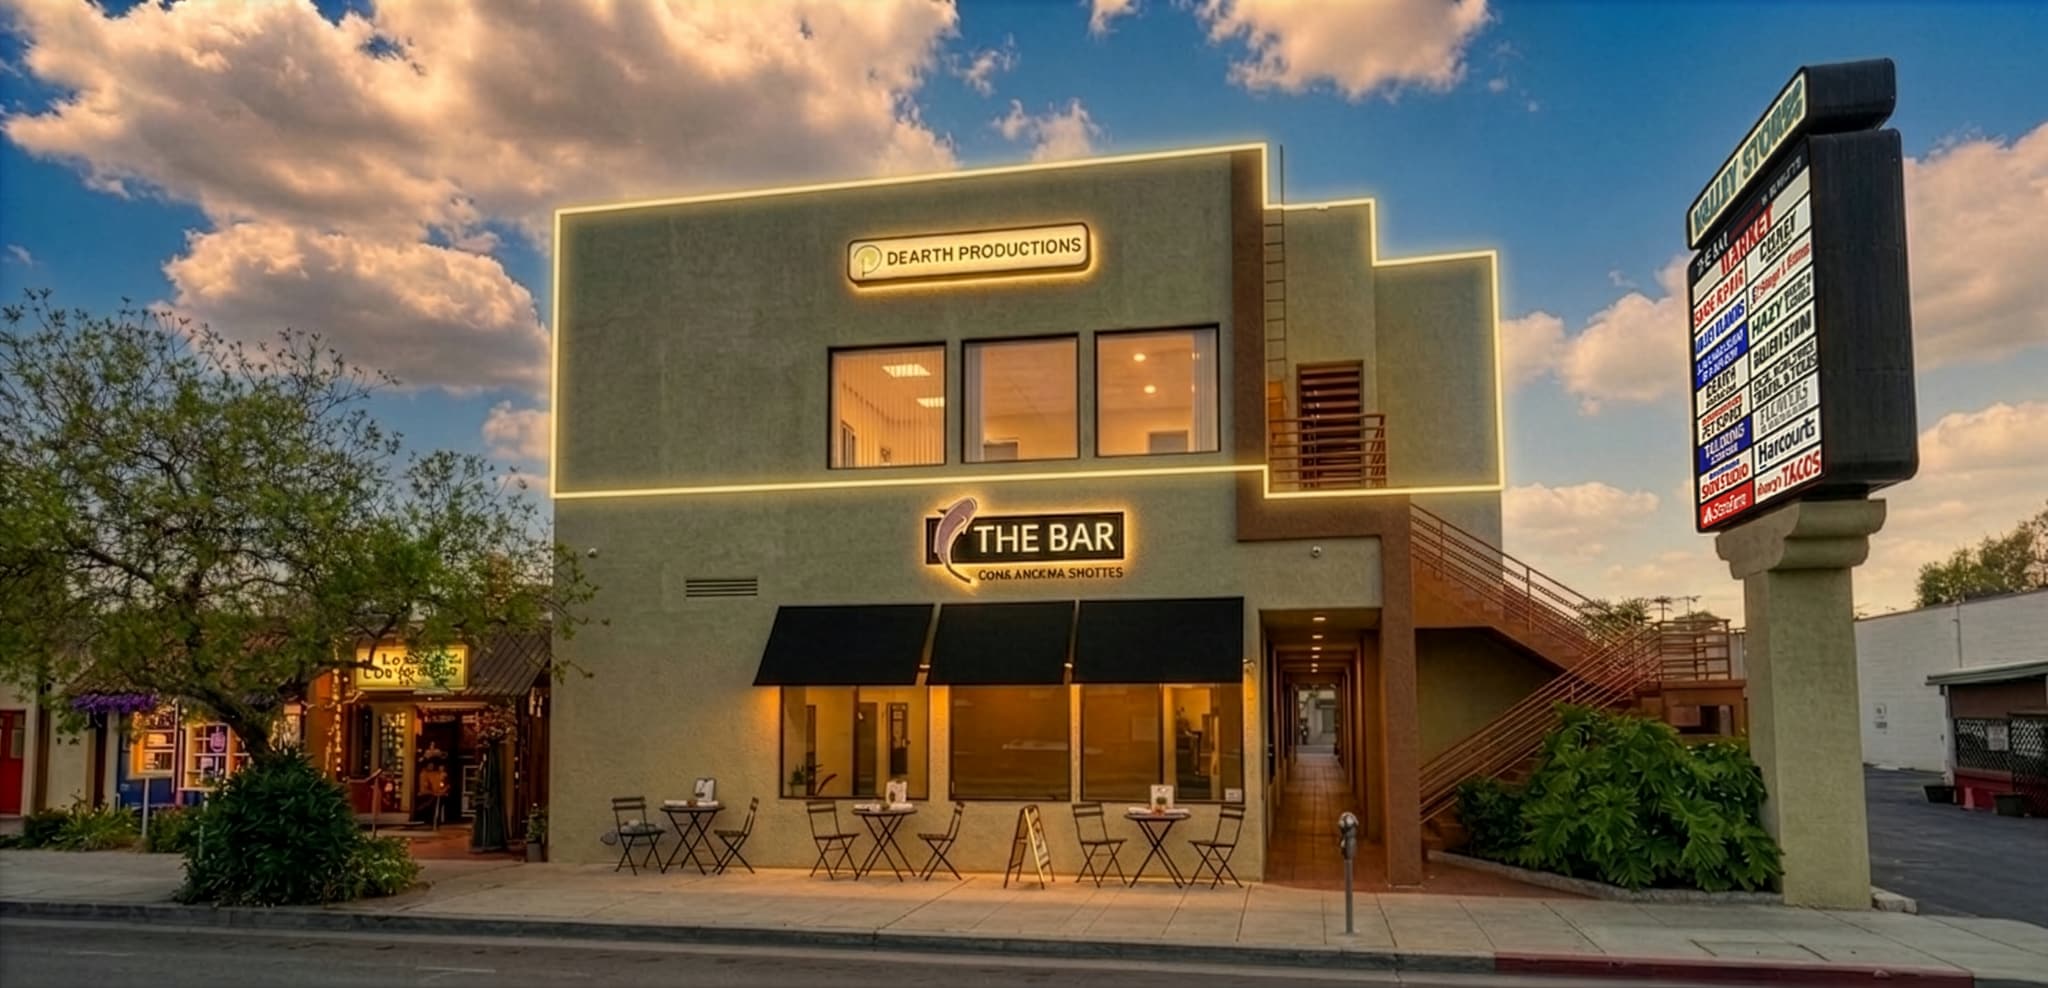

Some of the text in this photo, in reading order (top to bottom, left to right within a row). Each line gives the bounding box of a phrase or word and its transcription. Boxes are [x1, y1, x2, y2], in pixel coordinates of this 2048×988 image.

[887, 237, 1082, 266] DEARTH PRODUCTIONS
[1751, 296, 1783, 340] HAZY
[1758, 418, 1815, 466] Harcourts
[1782, 450, 1820, 488] TACOS
[974, 522, 1116, 554] THE BAR
